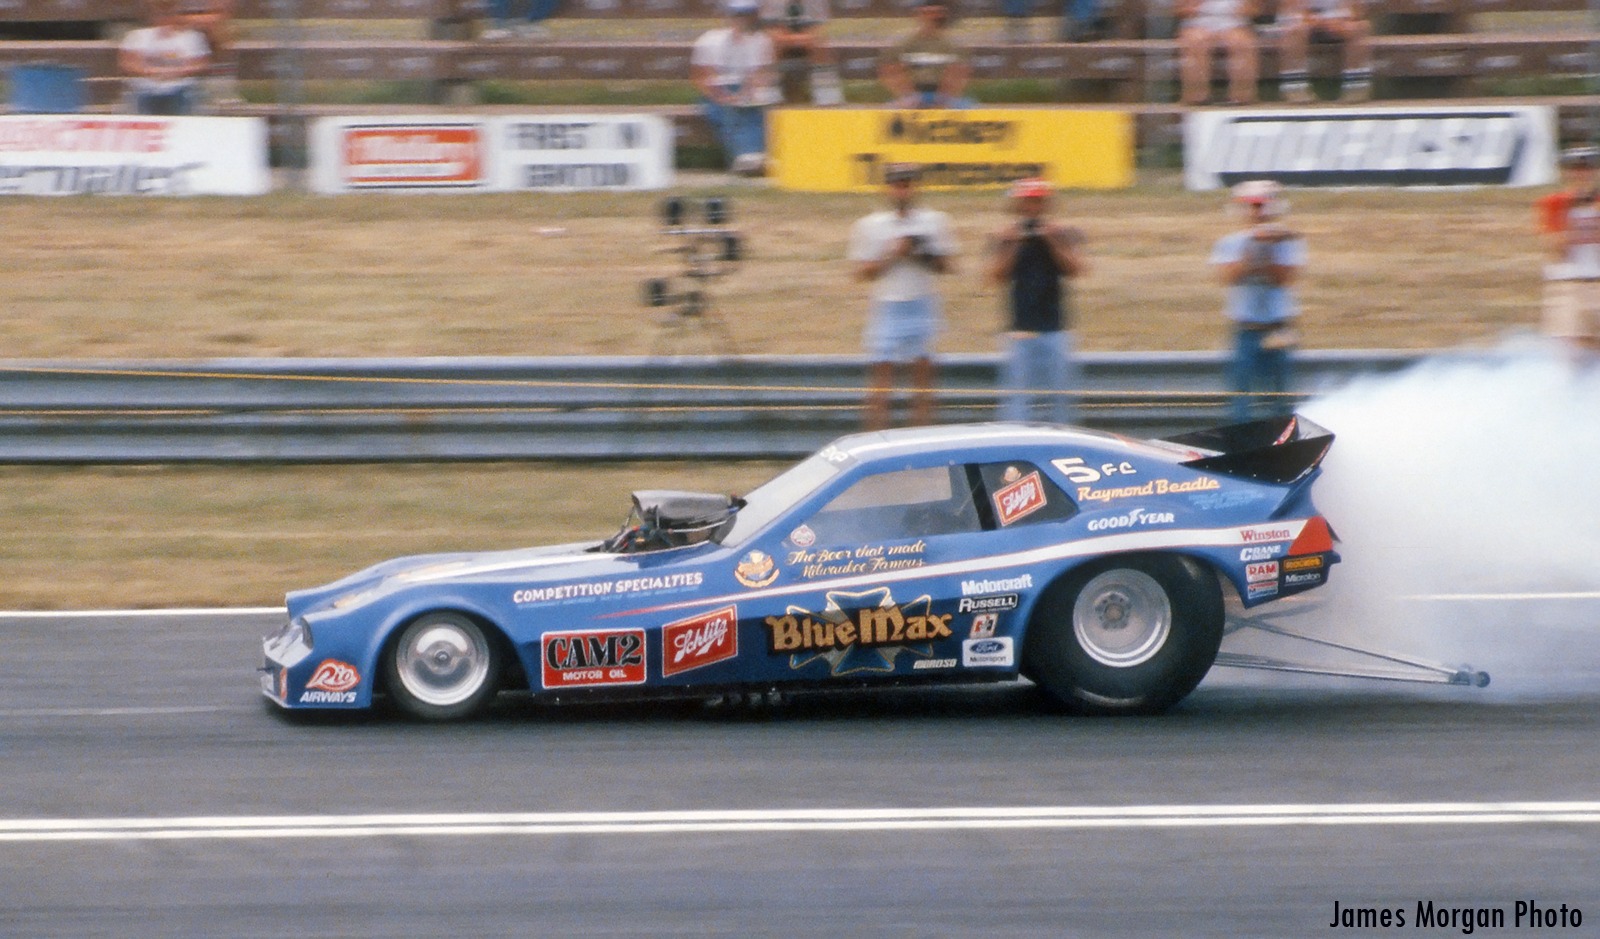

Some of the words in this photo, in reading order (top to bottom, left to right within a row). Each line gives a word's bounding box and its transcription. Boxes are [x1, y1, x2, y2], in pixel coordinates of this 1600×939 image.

[1051, 457, 1101, 483] 5
[1077, 481, 1153, 502] Raymond
[1155, 477, 1220, 494] Beadle
[1240, 529, 1290, 541] Winston
[787, 550, 816, 565] The
[856, 544, 883, 558] that
[888, 540, 926, 554] made
[1240, 545, 1281, 561] CRANE
[803, 562, 868, 578] Milwaukee
[513, 582, 613, 604] COMPETITION
[616, 572, 704, 593] SPECIALTIES
[961, 573, 1033, 595] Motorcraft
[958, 596, 1015, 613] RUSSELL
[674, 618, 728, 663] Schlitz
[547, 633, 642, 671] CAM2
[563, 670, 603, 681] MOTOR
[609, 669, 627, 679] OIL
[300, 691, 357, 703] AIRWAYS
